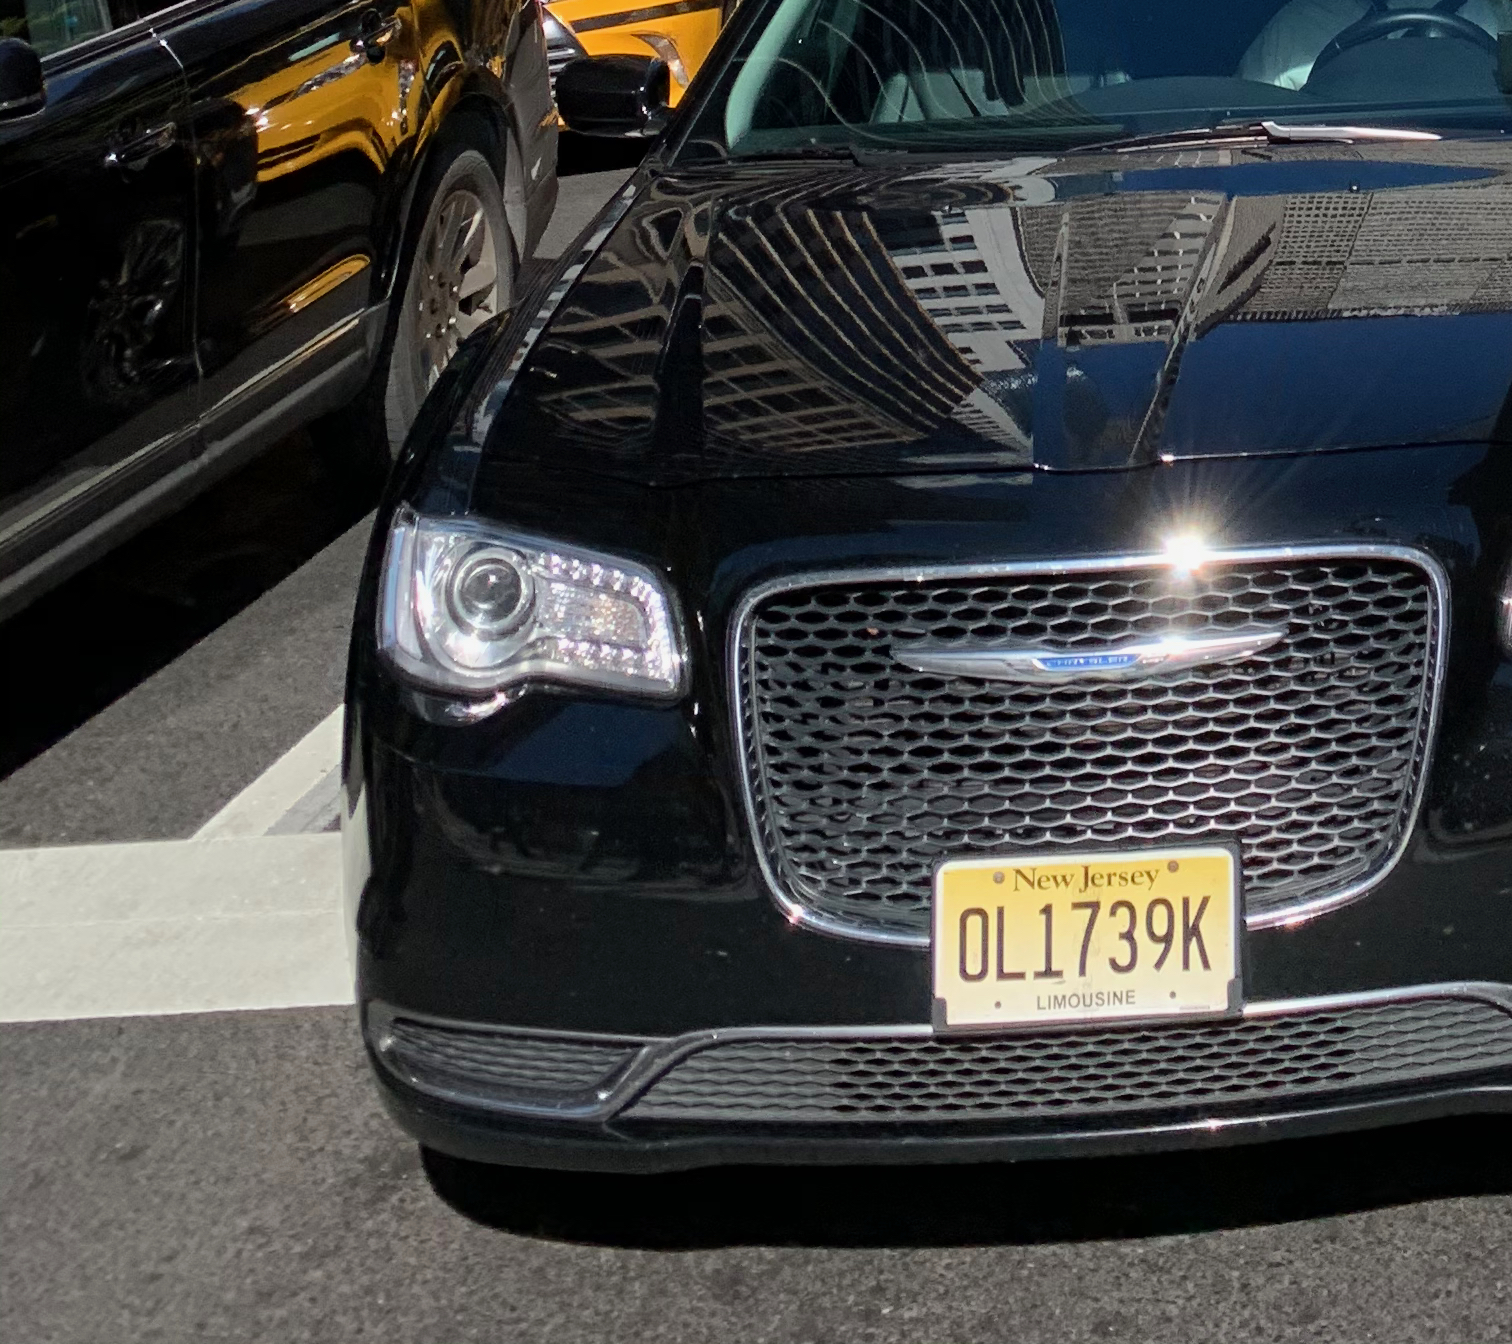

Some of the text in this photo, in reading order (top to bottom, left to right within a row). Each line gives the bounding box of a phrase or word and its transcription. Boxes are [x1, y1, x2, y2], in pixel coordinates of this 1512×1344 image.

[1013, 865, 1160, 893] New Jersey
[1036, 989, 1136, 1011] LIMOUSINE
